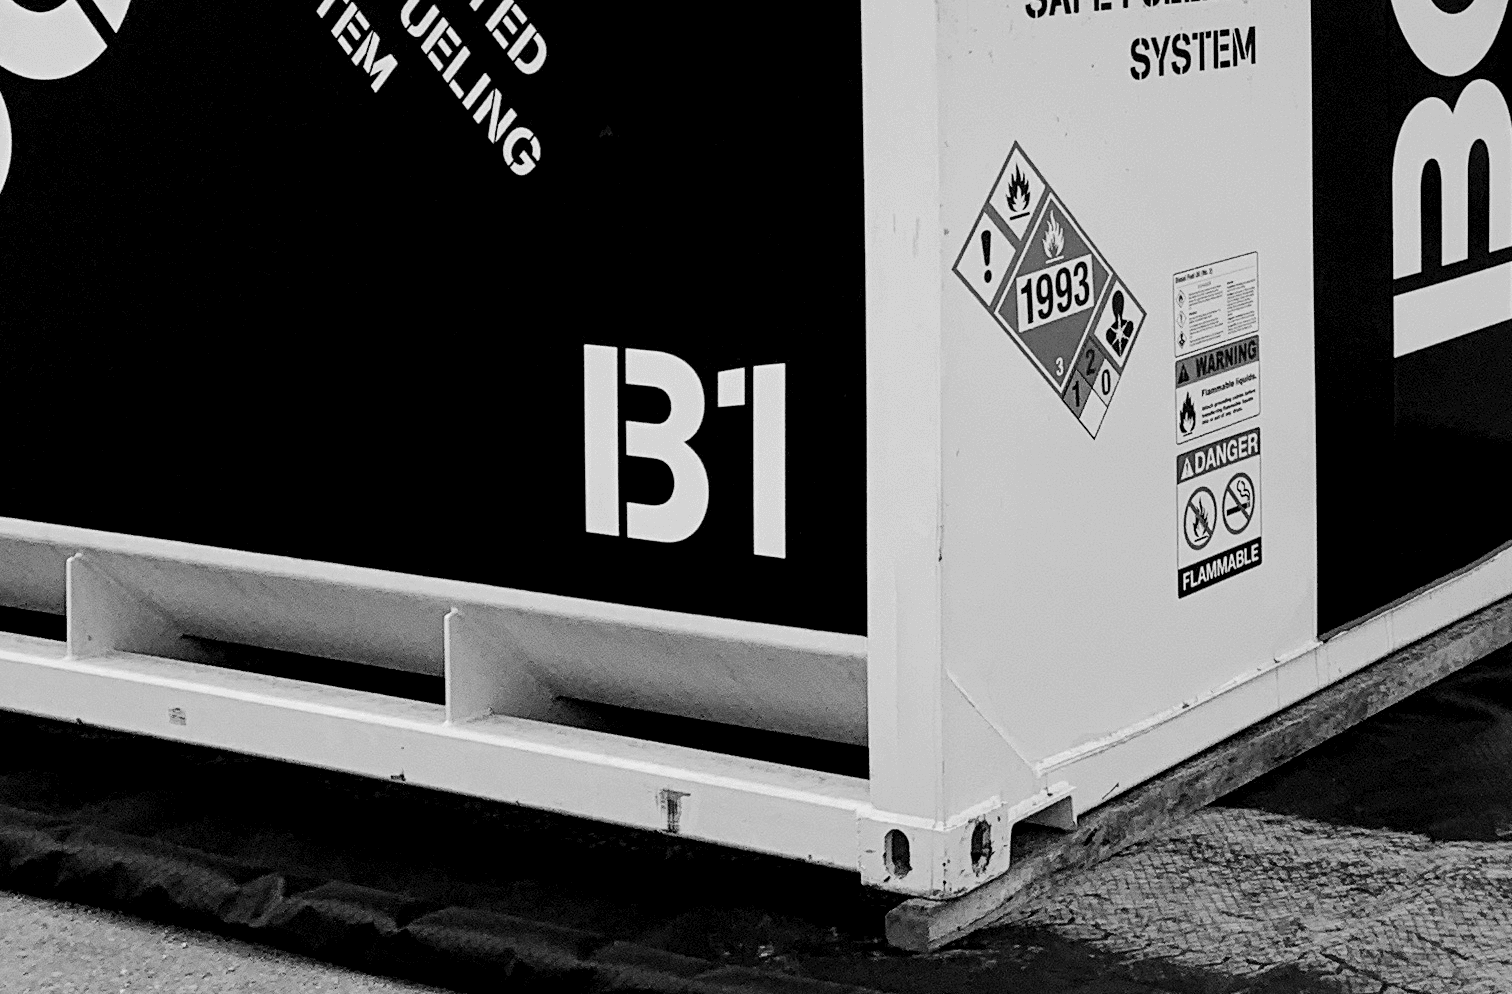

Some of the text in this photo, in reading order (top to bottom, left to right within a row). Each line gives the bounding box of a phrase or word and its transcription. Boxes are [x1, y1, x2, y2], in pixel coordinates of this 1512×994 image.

[1130, 26, 1257, 81] SYSTEM
[1020, 261, 1090, 325] 1993
[1055, 356, 1064, 377] 3
[1085, 348, 1096, 377] 2
[1195, 339, 1257, 378] WARNING
[1072, 368, 1111, 408] 1 0
[1201, 380, 1235, 397] Flammable
[584, 344, 787, 559] B1
[1194, 432, 1259, 474] DANGER
[1182, 543, 1260, 591] FLAMMABLE
